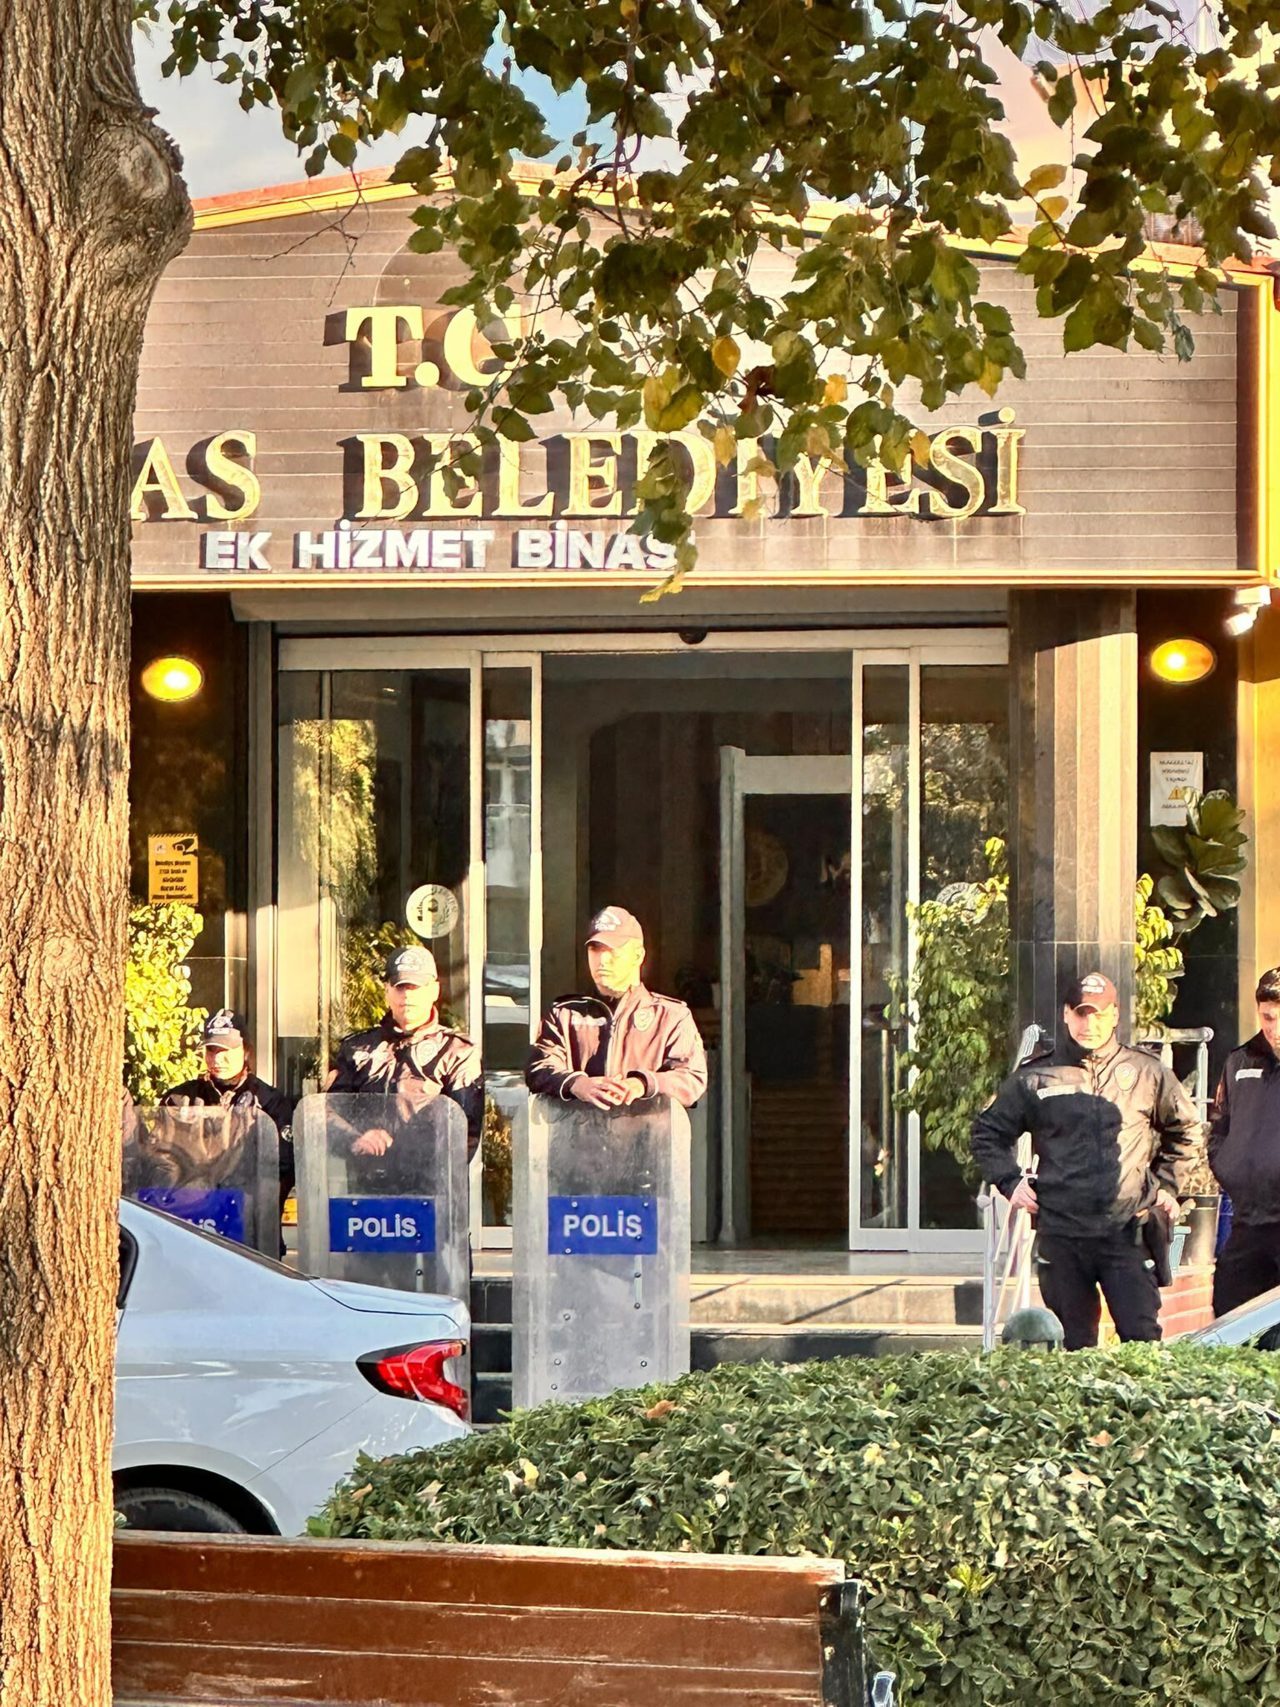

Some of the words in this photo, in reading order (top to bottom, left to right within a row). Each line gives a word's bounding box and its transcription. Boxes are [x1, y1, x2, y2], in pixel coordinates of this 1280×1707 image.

[206, 531, 272, 570] EK
[299, 519, 495, 569] HİZMET
[518, 520, 696, 571] BİNAS
[348, 1213, 417, 1238] POLİS
[563, 1210, 643, 1237] POLİS
